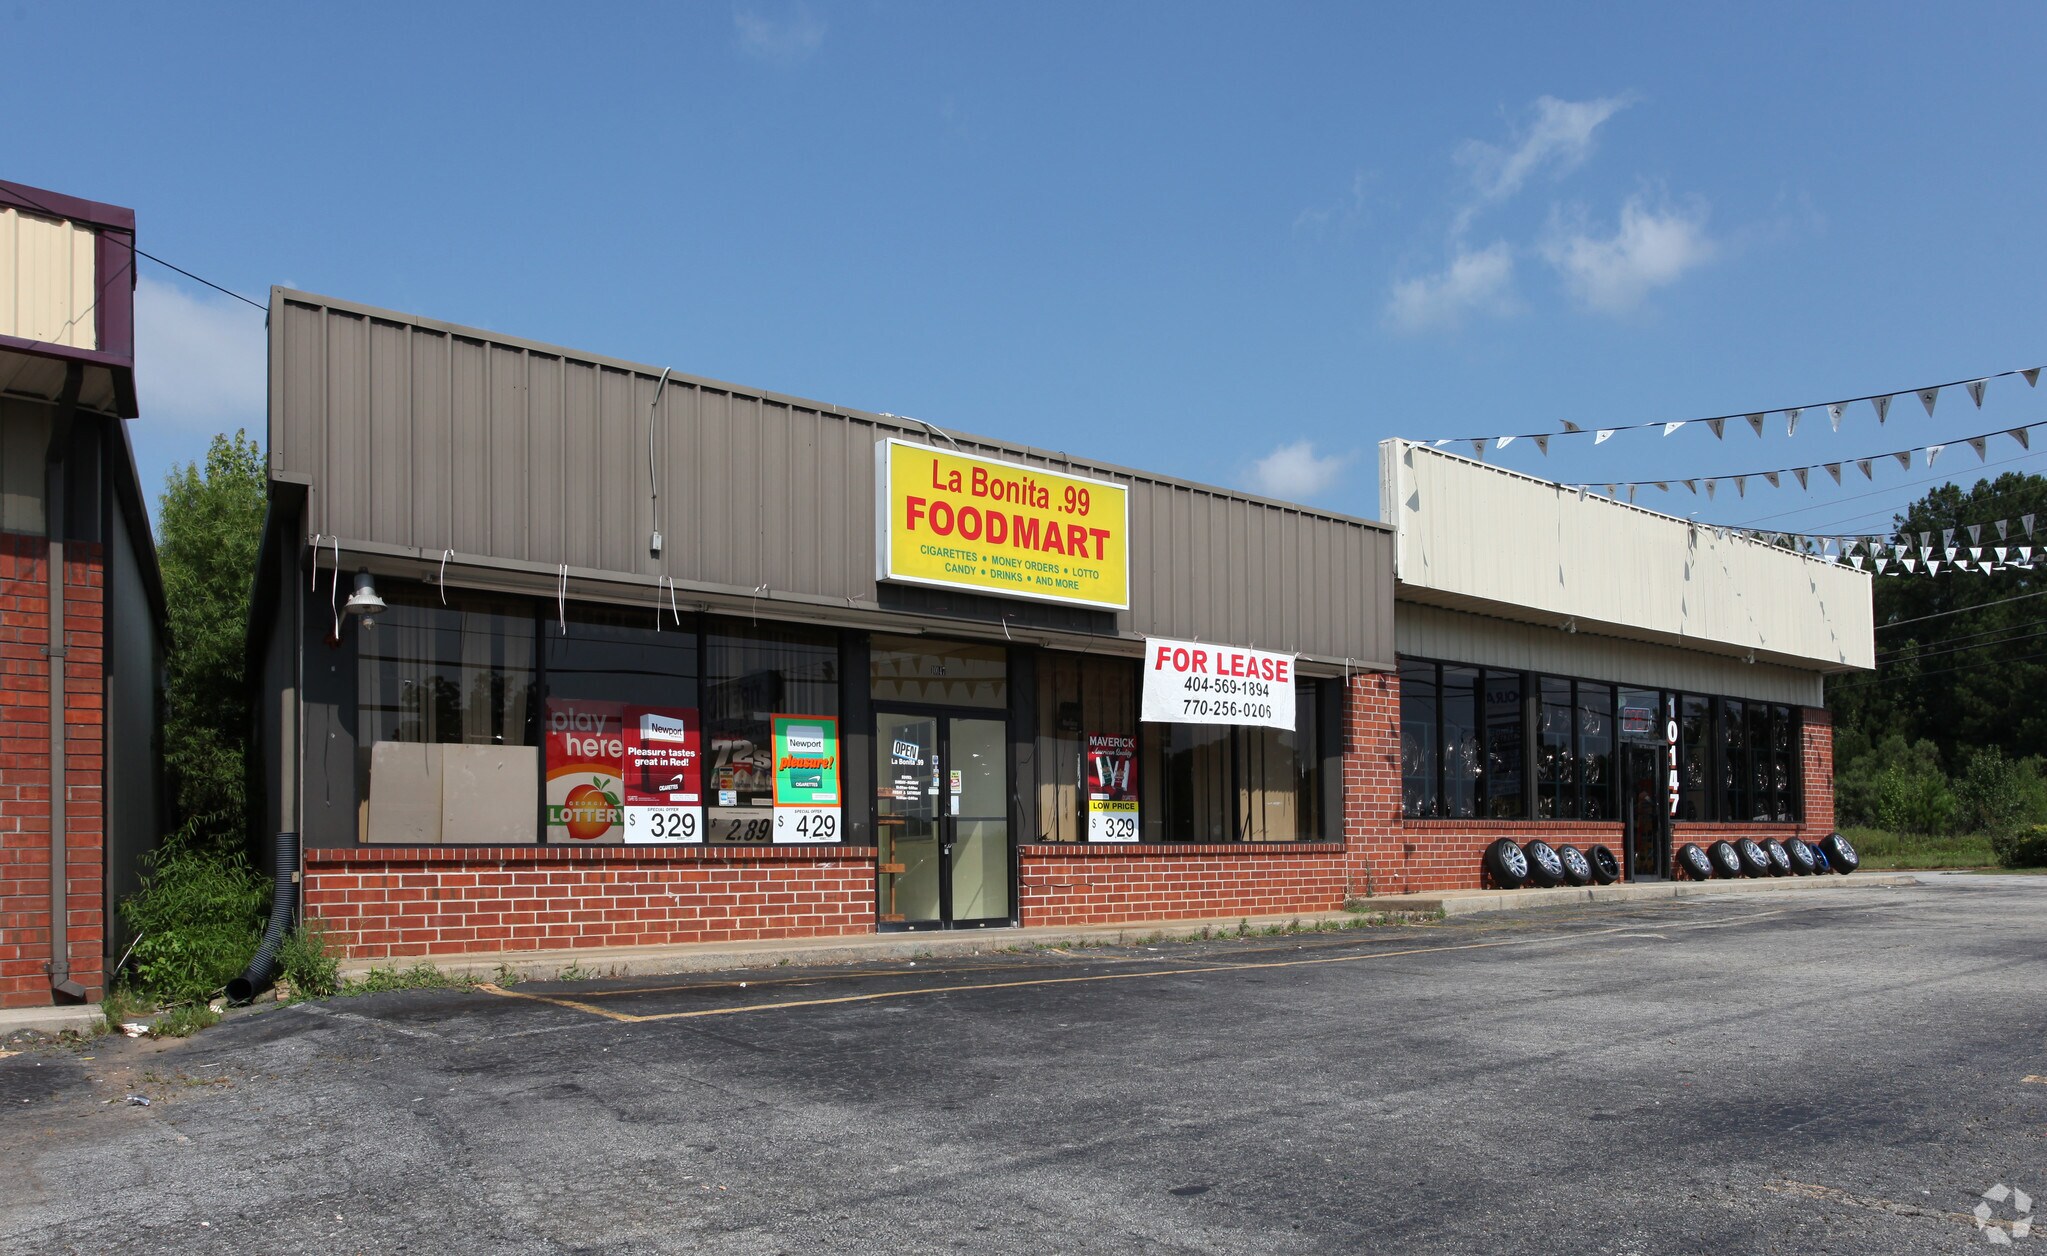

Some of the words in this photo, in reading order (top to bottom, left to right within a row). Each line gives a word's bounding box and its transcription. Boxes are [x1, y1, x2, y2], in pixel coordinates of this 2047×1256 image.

[932, 459, 962, 494] La
[972, 466, 1049, 510] Bonita
[1058, 485, 1090, 517] .99
[906, 495, 1110, 560] FOODMART
[920, 544, 978, 562] CIGARETTES
[992, 555, 1022, 569] MONEY
[1024, 560, 1060, 574] ORDERS
[1072, 567, 1100, 580] LOTTO
[945, 562, 976, 576] CANDY
[990, 569, 1022, 582] DRINKS
[1036, 575, 1054, 587] AND
[1055, 578, 1080, 590] MORE
[1155, 646, 1208, 674] FOR
[1217, 652, 1288, 683] LEASE
[1184, 676, 1270, 697] 404-569-1894
[1184, 700, 1272, 718] 770-256-0206
[552, 708, 607, 736] play
[652, 722, 682, 736] Newport
[566, 733, 622, 758] here
[628, 747, 666, 756] Pleasure
[668, 748, 696, 757] tastes
[790, 738, 822, 748] Newport
[896, 742, 917, 758] OPEN
[1090, 736, 1134, 748] MAVERICK
[634, 758, 658, 767] great
[660, 758, 668, 766] in
[670, 758, 689, 767] Red!
[779, 754, 834, 772] pleasure!
[899, 758, 916, 766] Bonita
[1094, 802, 1110, 810] LOW
[1112, 802, 1135, 810] PRICE
[629, 814, 636, 826] $
[651, 813, 696, 839] 3.29
[726, 818, 770, 841] 2.89
[778, 816, 784, 828] $
[796, 814, 836, 839] 4.29
[1092, 818, 1096, 828] $
[1106, 818, 1134, 838] 3.29
